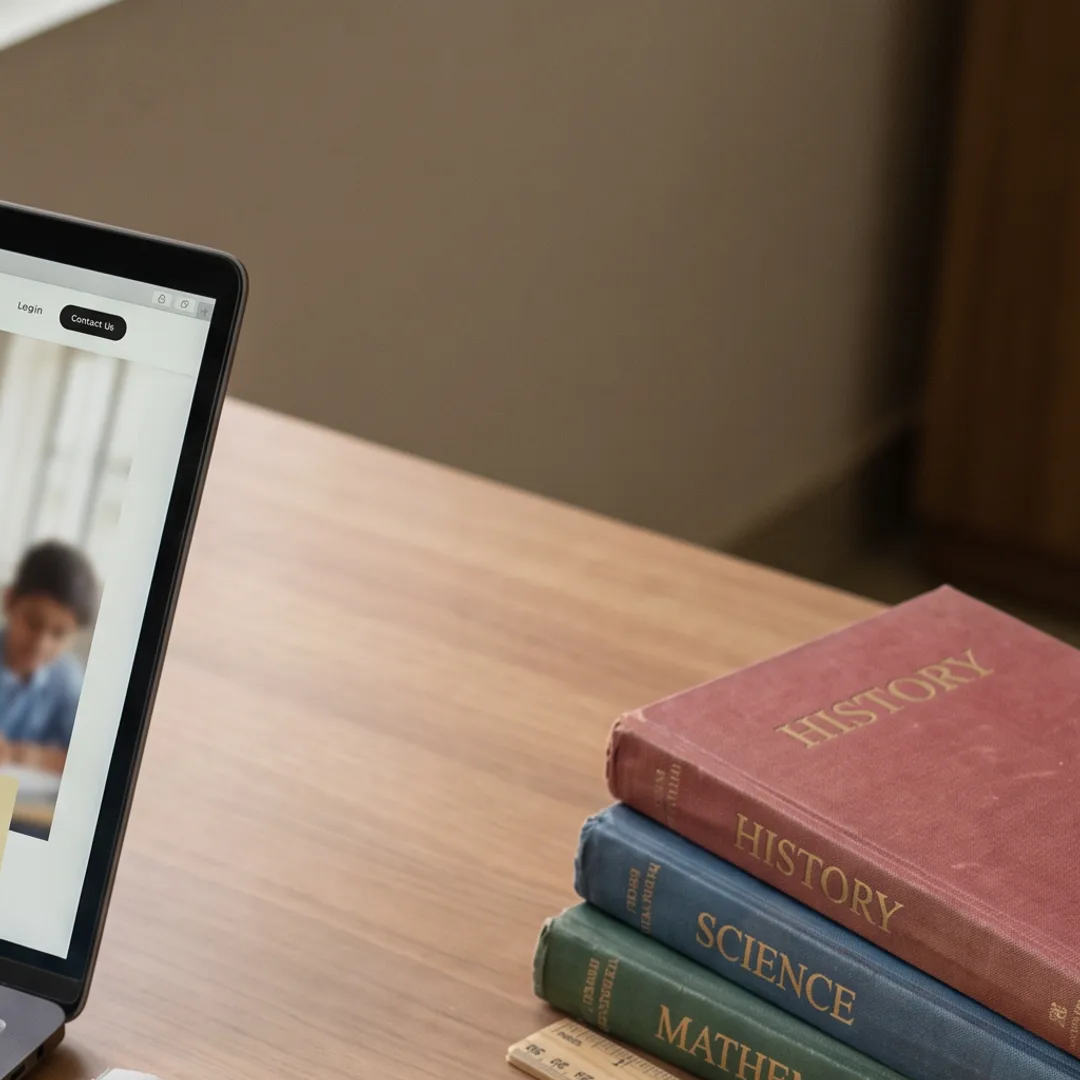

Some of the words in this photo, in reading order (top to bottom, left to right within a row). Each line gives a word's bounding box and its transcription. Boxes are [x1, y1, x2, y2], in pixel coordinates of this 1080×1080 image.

[71, 314, 102, 328] Contact
[104, 322, 115, 332] Us
[774, 649, 995, 749] HISTORY
[733, 812, 905, 934] HISTORY
[695, 912, 857, 1026] SCIENCE
